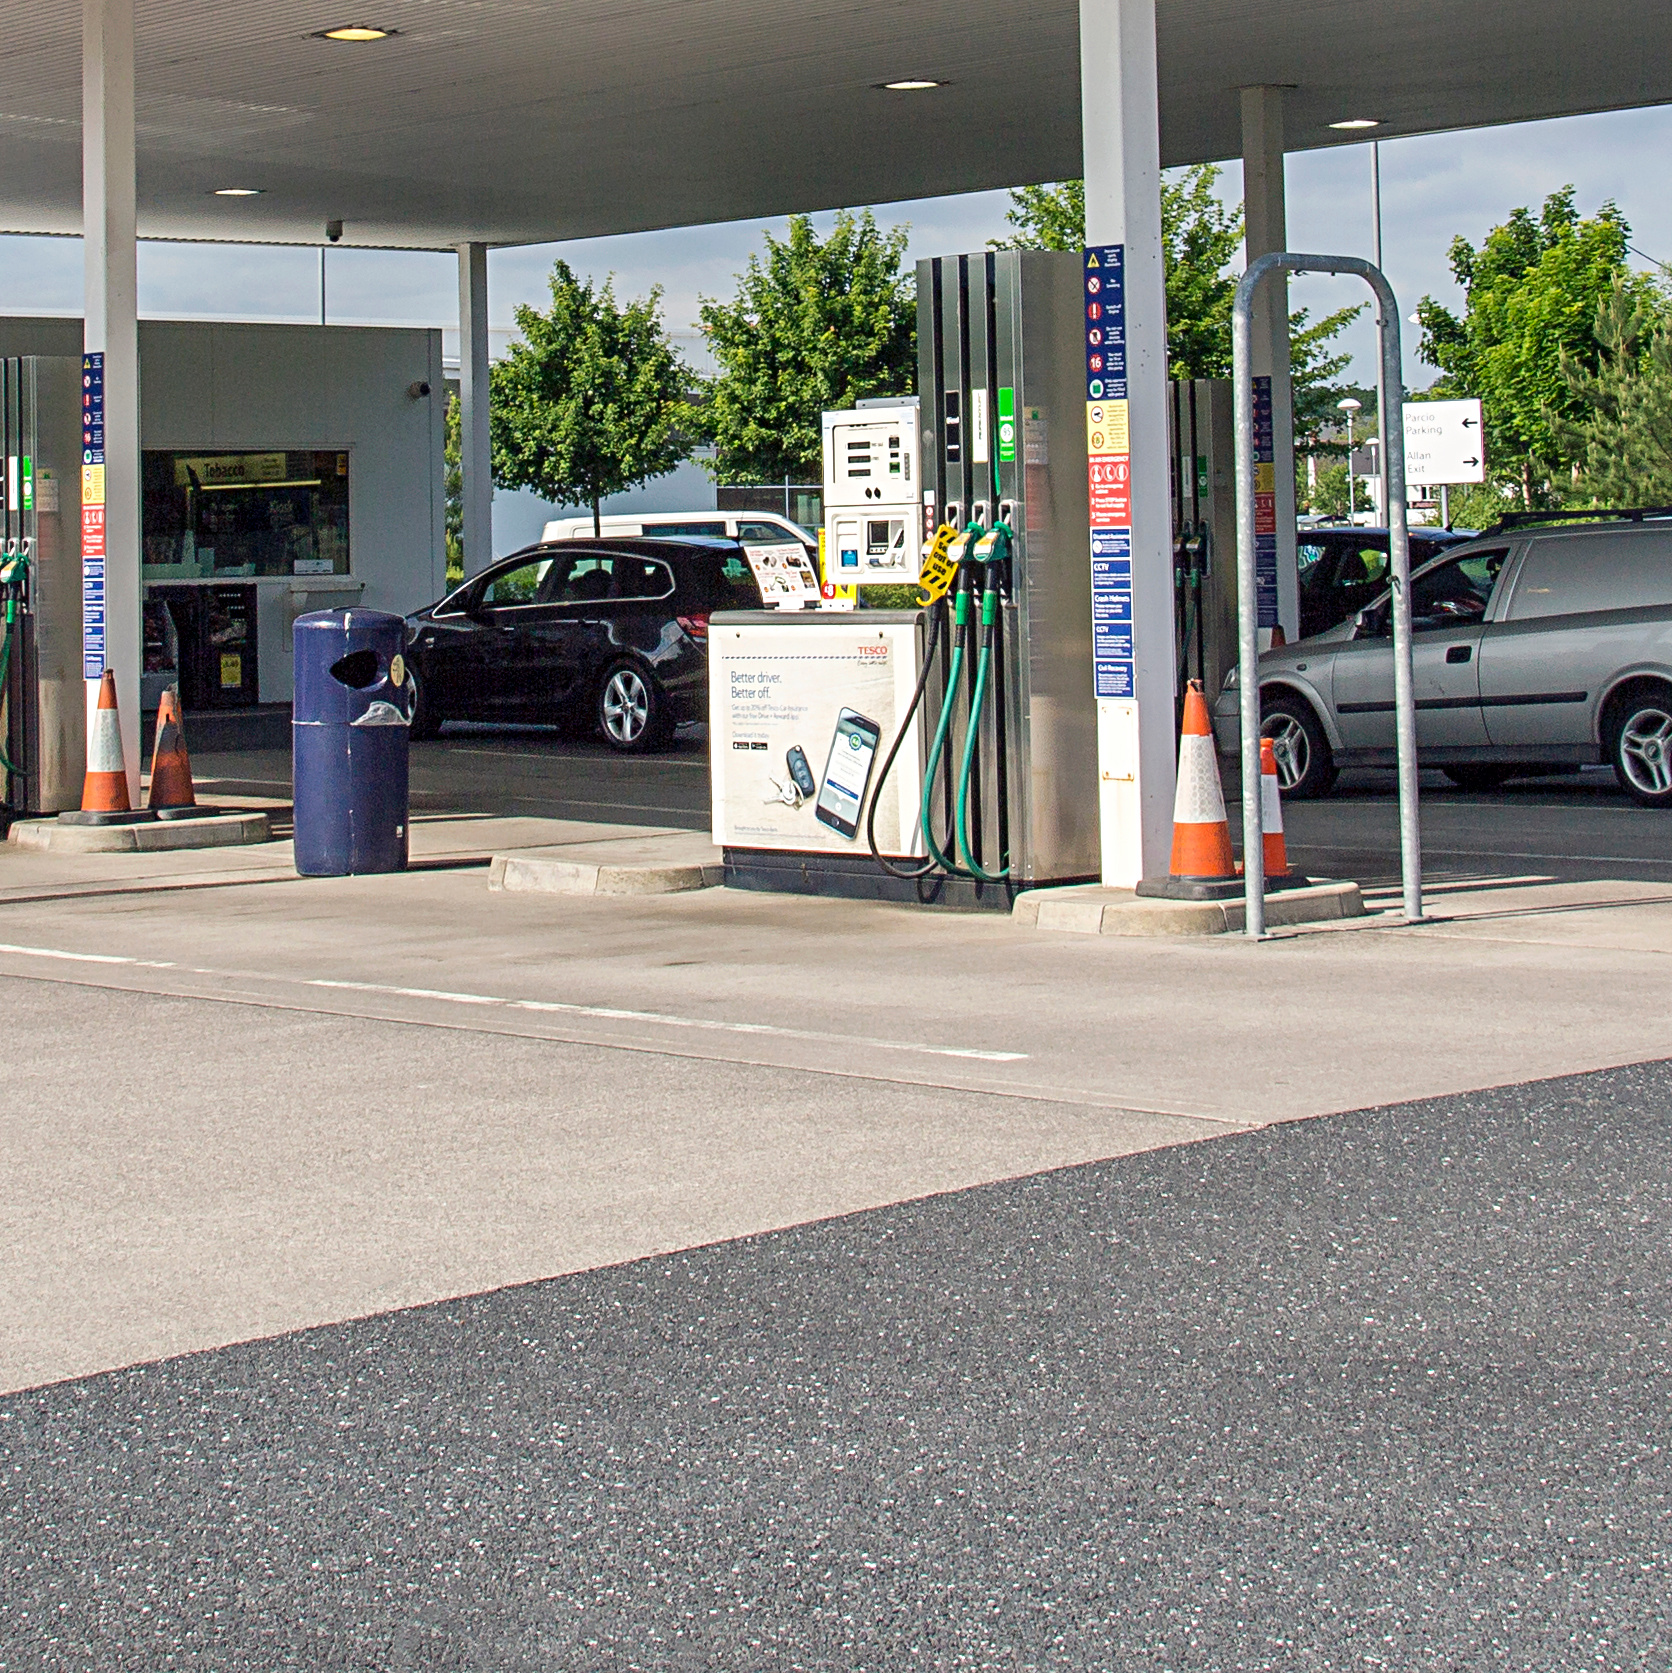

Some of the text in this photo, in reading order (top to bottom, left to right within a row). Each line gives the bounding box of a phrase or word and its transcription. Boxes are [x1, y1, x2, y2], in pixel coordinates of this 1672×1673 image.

[1090, 357, 1102, 368] 16
[1405, 413, 1436, 422] Parcio
[1406, 426, 1443, 436] Parking
[1407, 451, 1432, 460] Allan
[204, 462, 246, 478] Tobacco
[1408, 464, 1426, 473] Exit
[933, 551, 947, 563] out
[932, 563, 947, 576] use
[1093, 562, 1109, 571] CCTV
[858, 646, 887, 655] TESCO
[731, 671, 782, 683] Better driver.
[731, 686, 771, 699] Better off.
